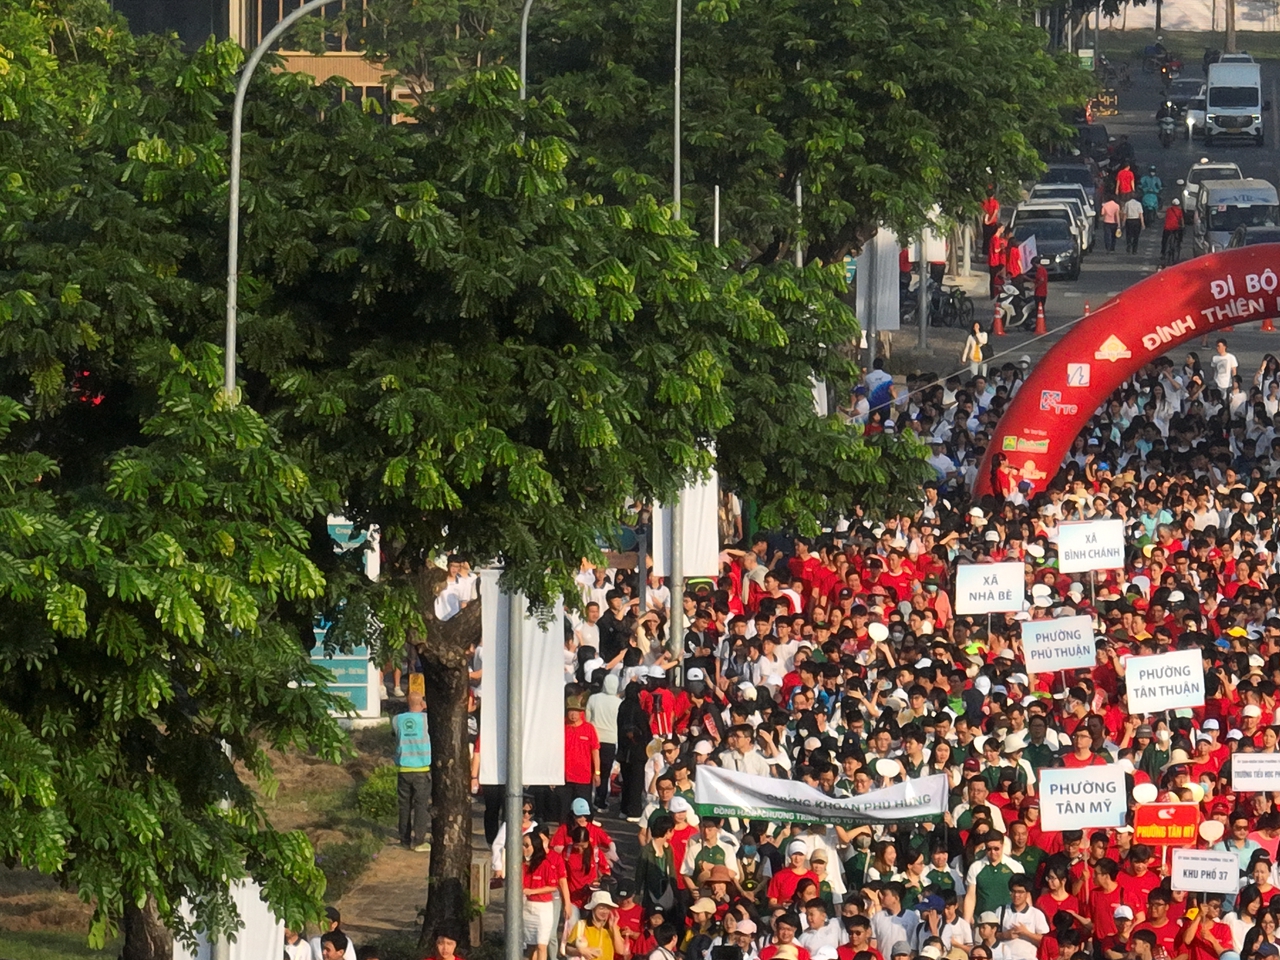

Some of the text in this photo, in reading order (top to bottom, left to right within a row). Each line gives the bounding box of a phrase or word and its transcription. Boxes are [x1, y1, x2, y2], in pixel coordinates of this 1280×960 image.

[1245, 268, 1278, 295] BỘ
[1201, 297, 1265, 323] THIỆN
[1085, 534, 1098, 544] XÃ
[1088, 548, 1120, 559] CHÁNH
[983, 576, 999, 587] XÃ
[969, 588, 995, 602] NHÀ
[1035, 630, 1082, 643] PHƯỜNG
[1055, 645, 1091, 659] THUẬN
[1139, 665, 1191, 681] PHƯỜNG
[1133, 682, 1200, 699] TÂN THUẬN
[1050, 781, 1117, 796] PHƯỜNG
[1056, 799, 1112, 815] TÂN MỸ
[1136, 825, 1166, 839] PHƯỜNG
[1182, 867, 1229, 881] KHU PHỐ 37
